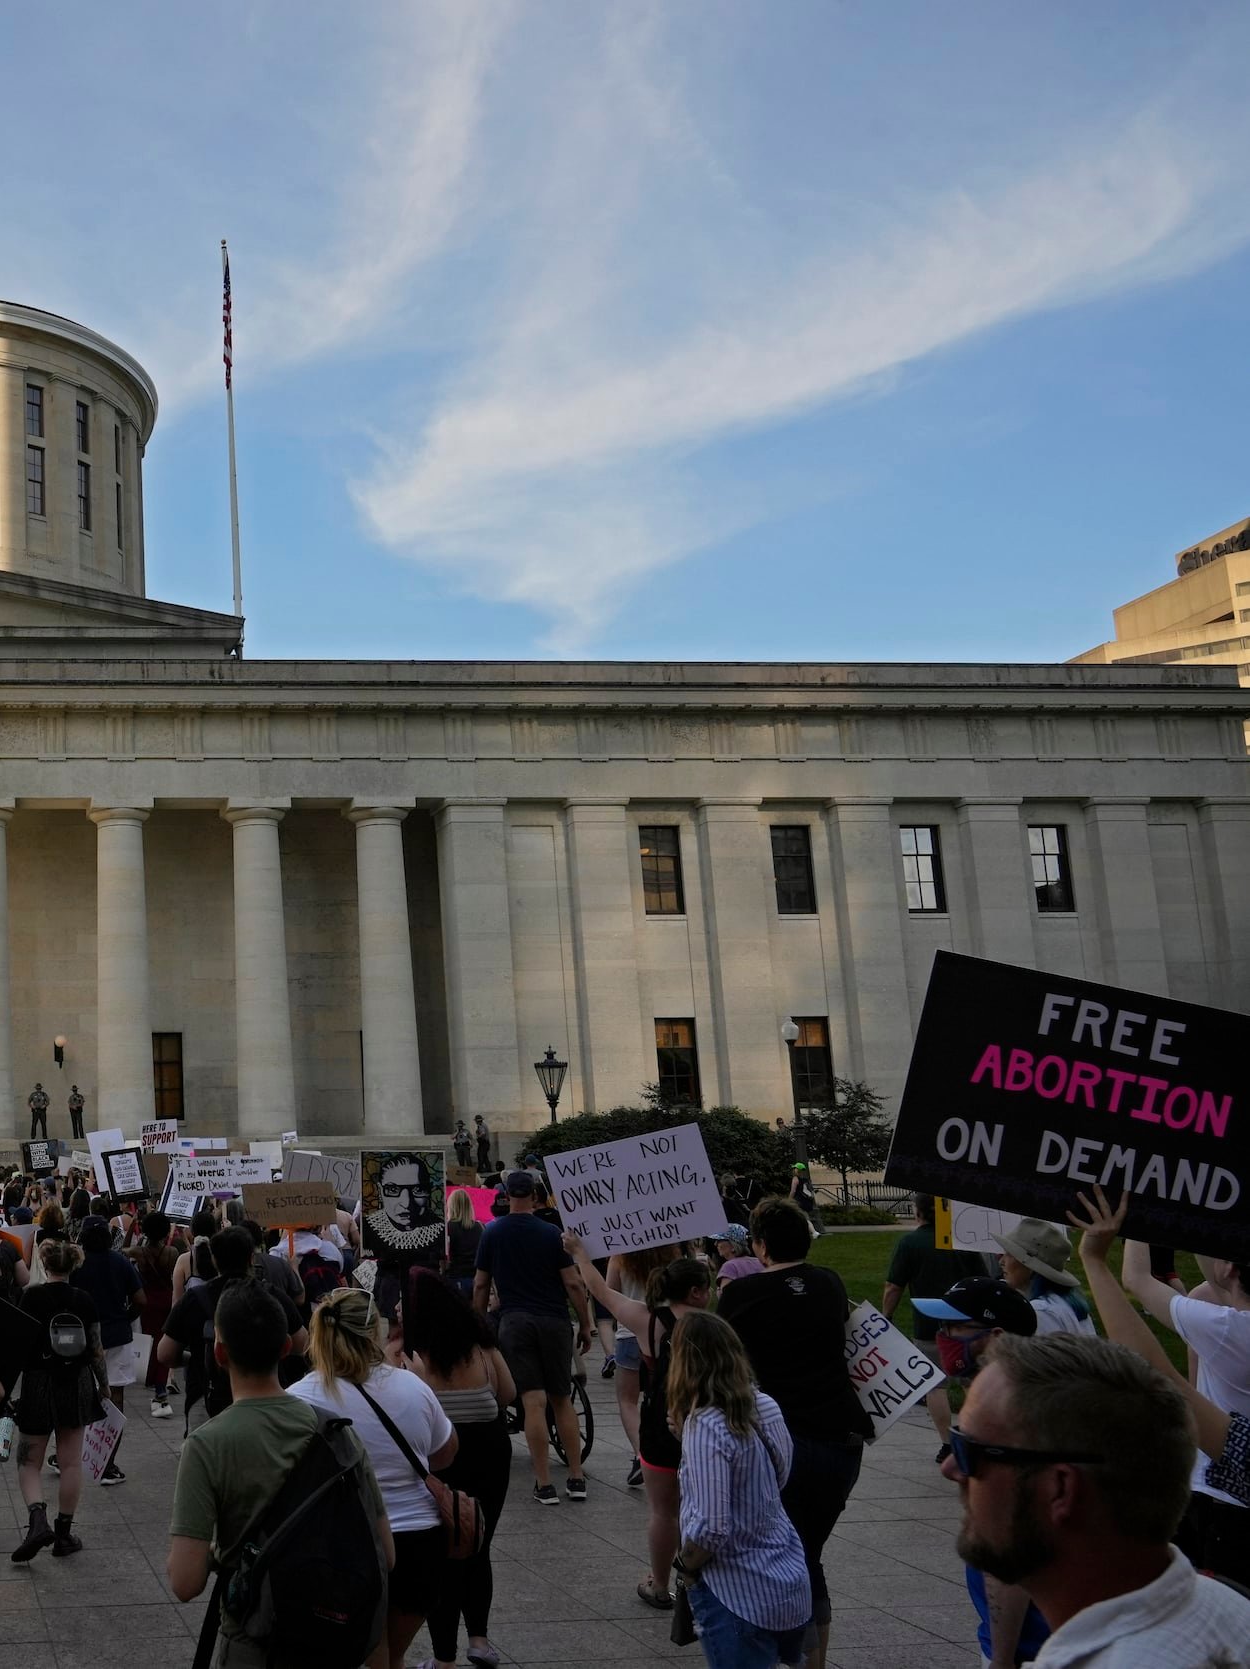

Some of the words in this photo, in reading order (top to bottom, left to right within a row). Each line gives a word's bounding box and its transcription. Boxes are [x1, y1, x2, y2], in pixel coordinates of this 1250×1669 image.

[1037, 992, 1187, 1066] FREE
[969, 1043, 1233, 1138] ABORTION
[142, 1123, 157, 1133] HERE
[158, 1122, 167, 1131] TO
[142, 1130, 177, 1147] SUPPORT
[553, 1149, 616, 1178] WE'RE
[639, 1134, 678, 1160] NOT
[935, 1116, 1006, 1167] ON
[1035, 1129, 1241, 1211] DEMAND
[177, 1181, 205, 1191] FUCKED
[567, 1220, 591, 1238] WE
[600, 1210, 645, 1234] JUST
[649, 1200, 698, 1224] WANT
[602, 1224, 682, 1251] RIGHTS!
[843, 1313, 890, 1358] DGES
[849, 1346, 890, 1392] NOT
